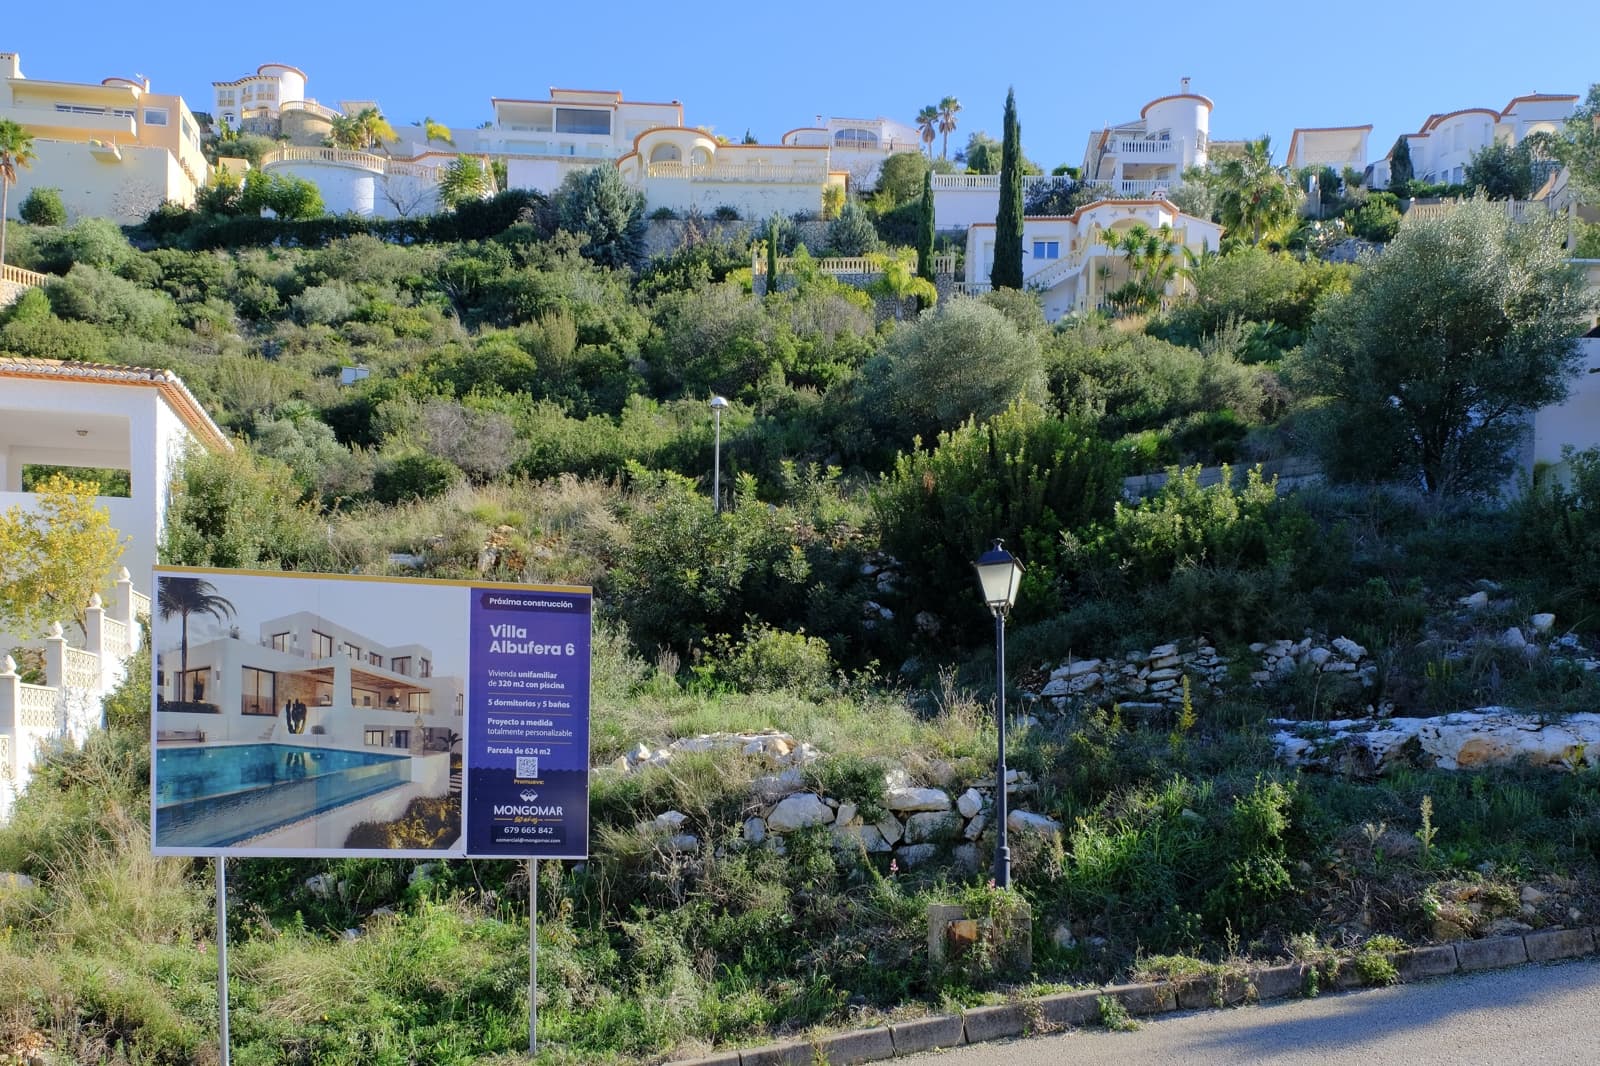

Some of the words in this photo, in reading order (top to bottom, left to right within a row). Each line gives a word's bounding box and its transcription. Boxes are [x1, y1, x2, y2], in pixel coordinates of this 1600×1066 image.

[489, 597, 522, 606] Próxima
[522, 599, 573, 609] construcción
[489, 624, 527, 639] Villa
[489, 640, 562, 656] Albufera
[565, 643, 575, 656] 6
[488, 669, 517, 678] Vivienda
[518, 671, 558, 679] unifamiliar
[498, 680, 512, 688] 320
[513, 680, 525, 688] m2
[540, 682, 565, 690] piscina
[494, 699, 536, 707] dormitorios
[548, 700, 570, 709] baños
[488, 718, 519, 727] Proyecto
[526, 719, 553, 727] medida
[487, 728, 525, 736] totalmente
[525, 729, 573, 737] personalizable
[514, 747, 524, 755] de
[525, 747, 538, 755] 624
[493, 805, 563, 816] MONGOMAR
[504, 826, 520, 834] 679
[521, 826, 536, 834] 665
[538, 827, 553, 835] 842
